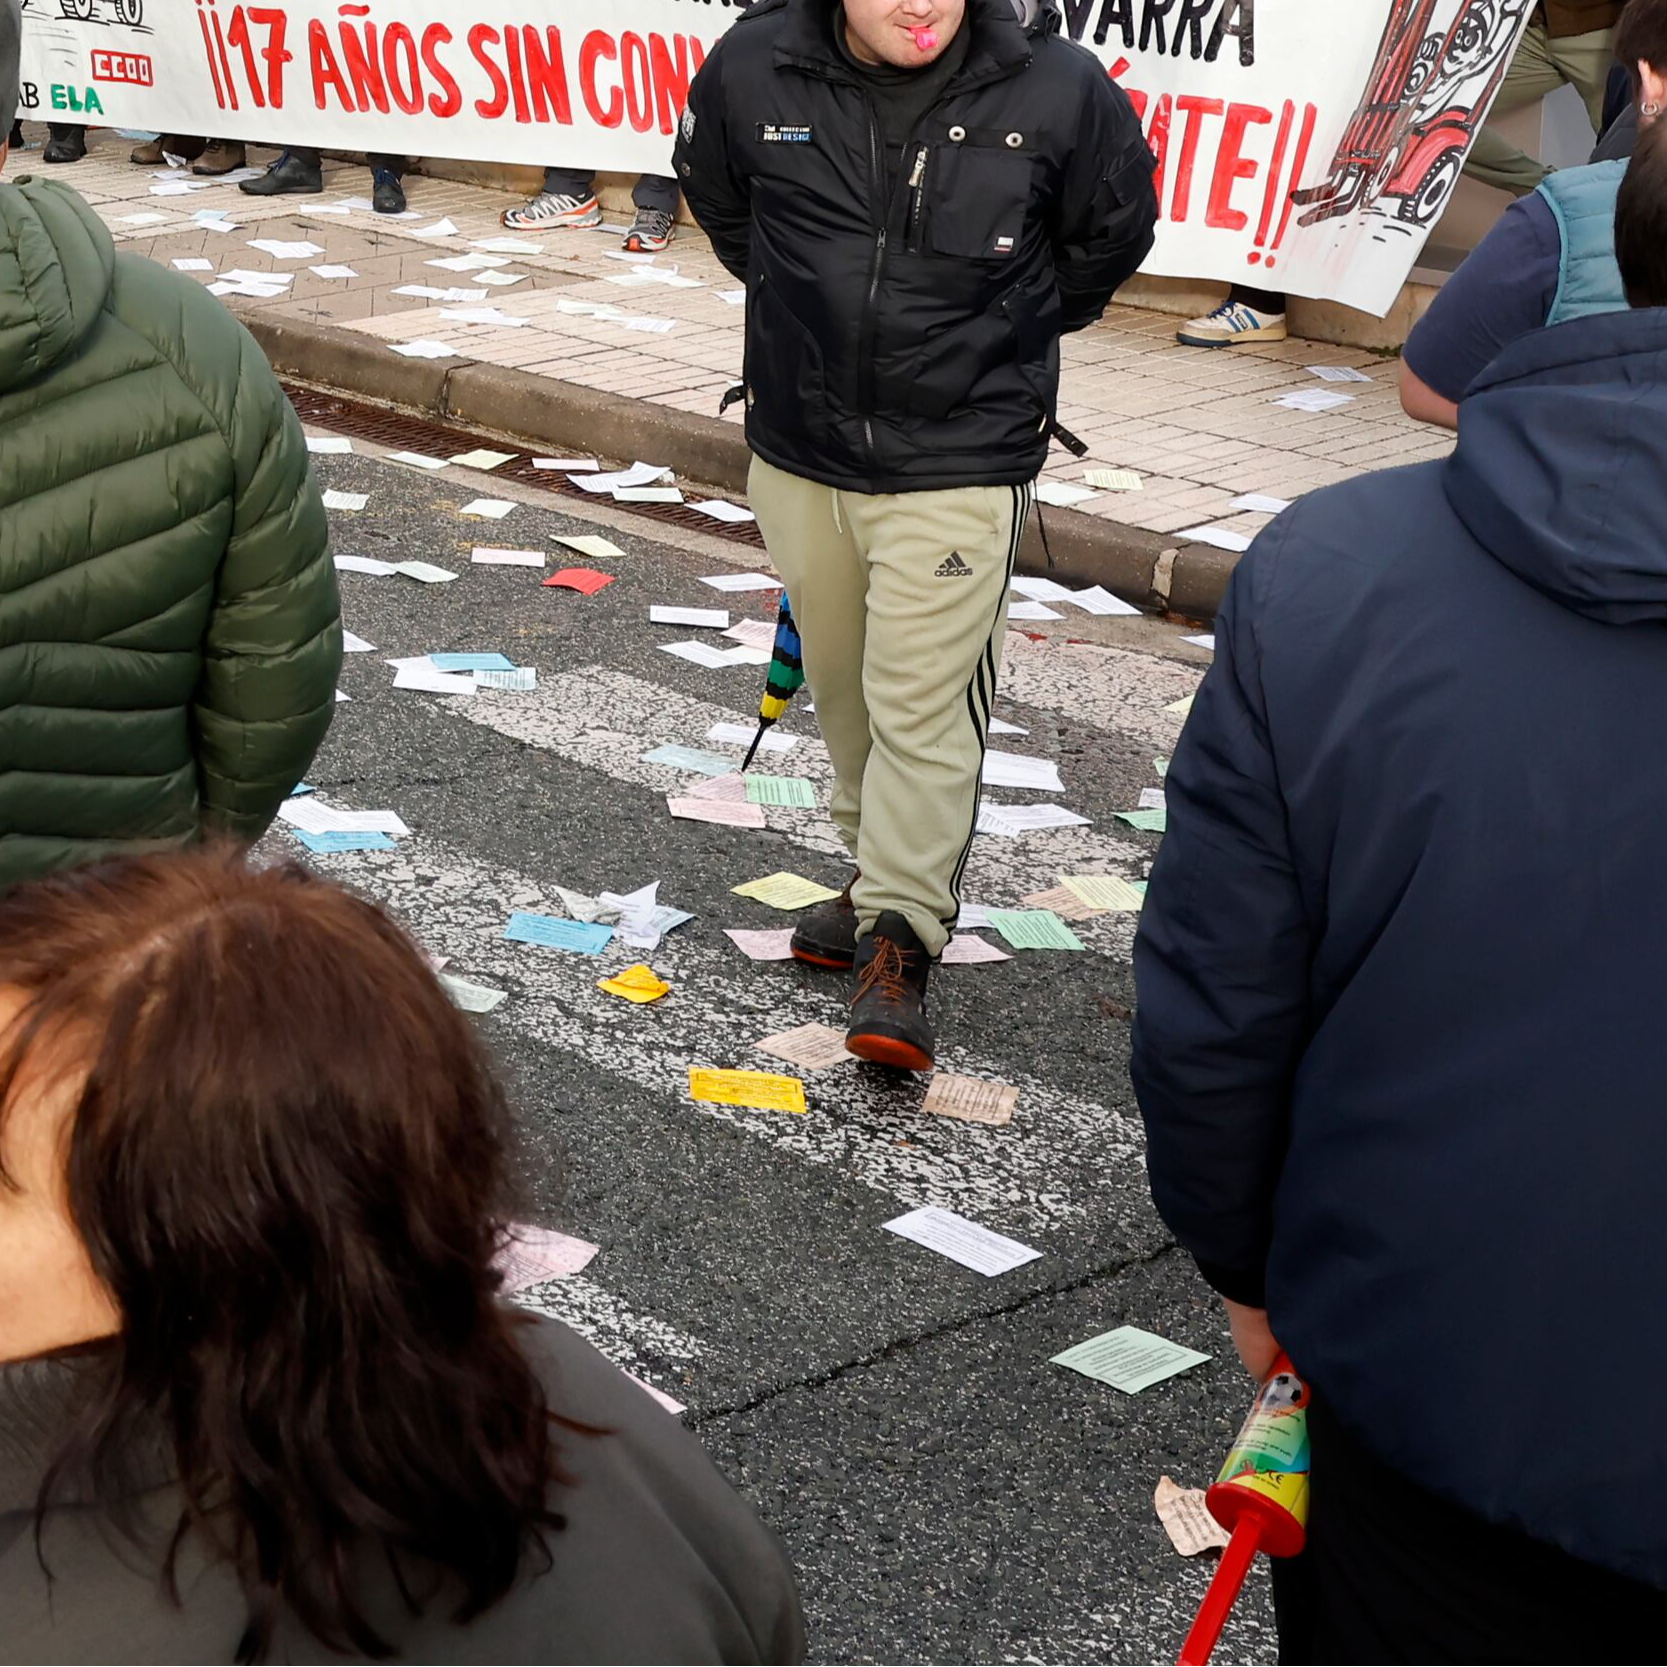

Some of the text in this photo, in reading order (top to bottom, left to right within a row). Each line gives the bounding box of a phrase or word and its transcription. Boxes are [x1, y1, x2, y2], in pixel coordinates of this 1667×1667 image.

[94, 53, 150, 83] CCOO
[308, 3, 463, 119] AÑOS
[467, 22, 574, 125] SIN
[51, 83, 104, 116] ELA
[934, 567, 973, 577] adidas
